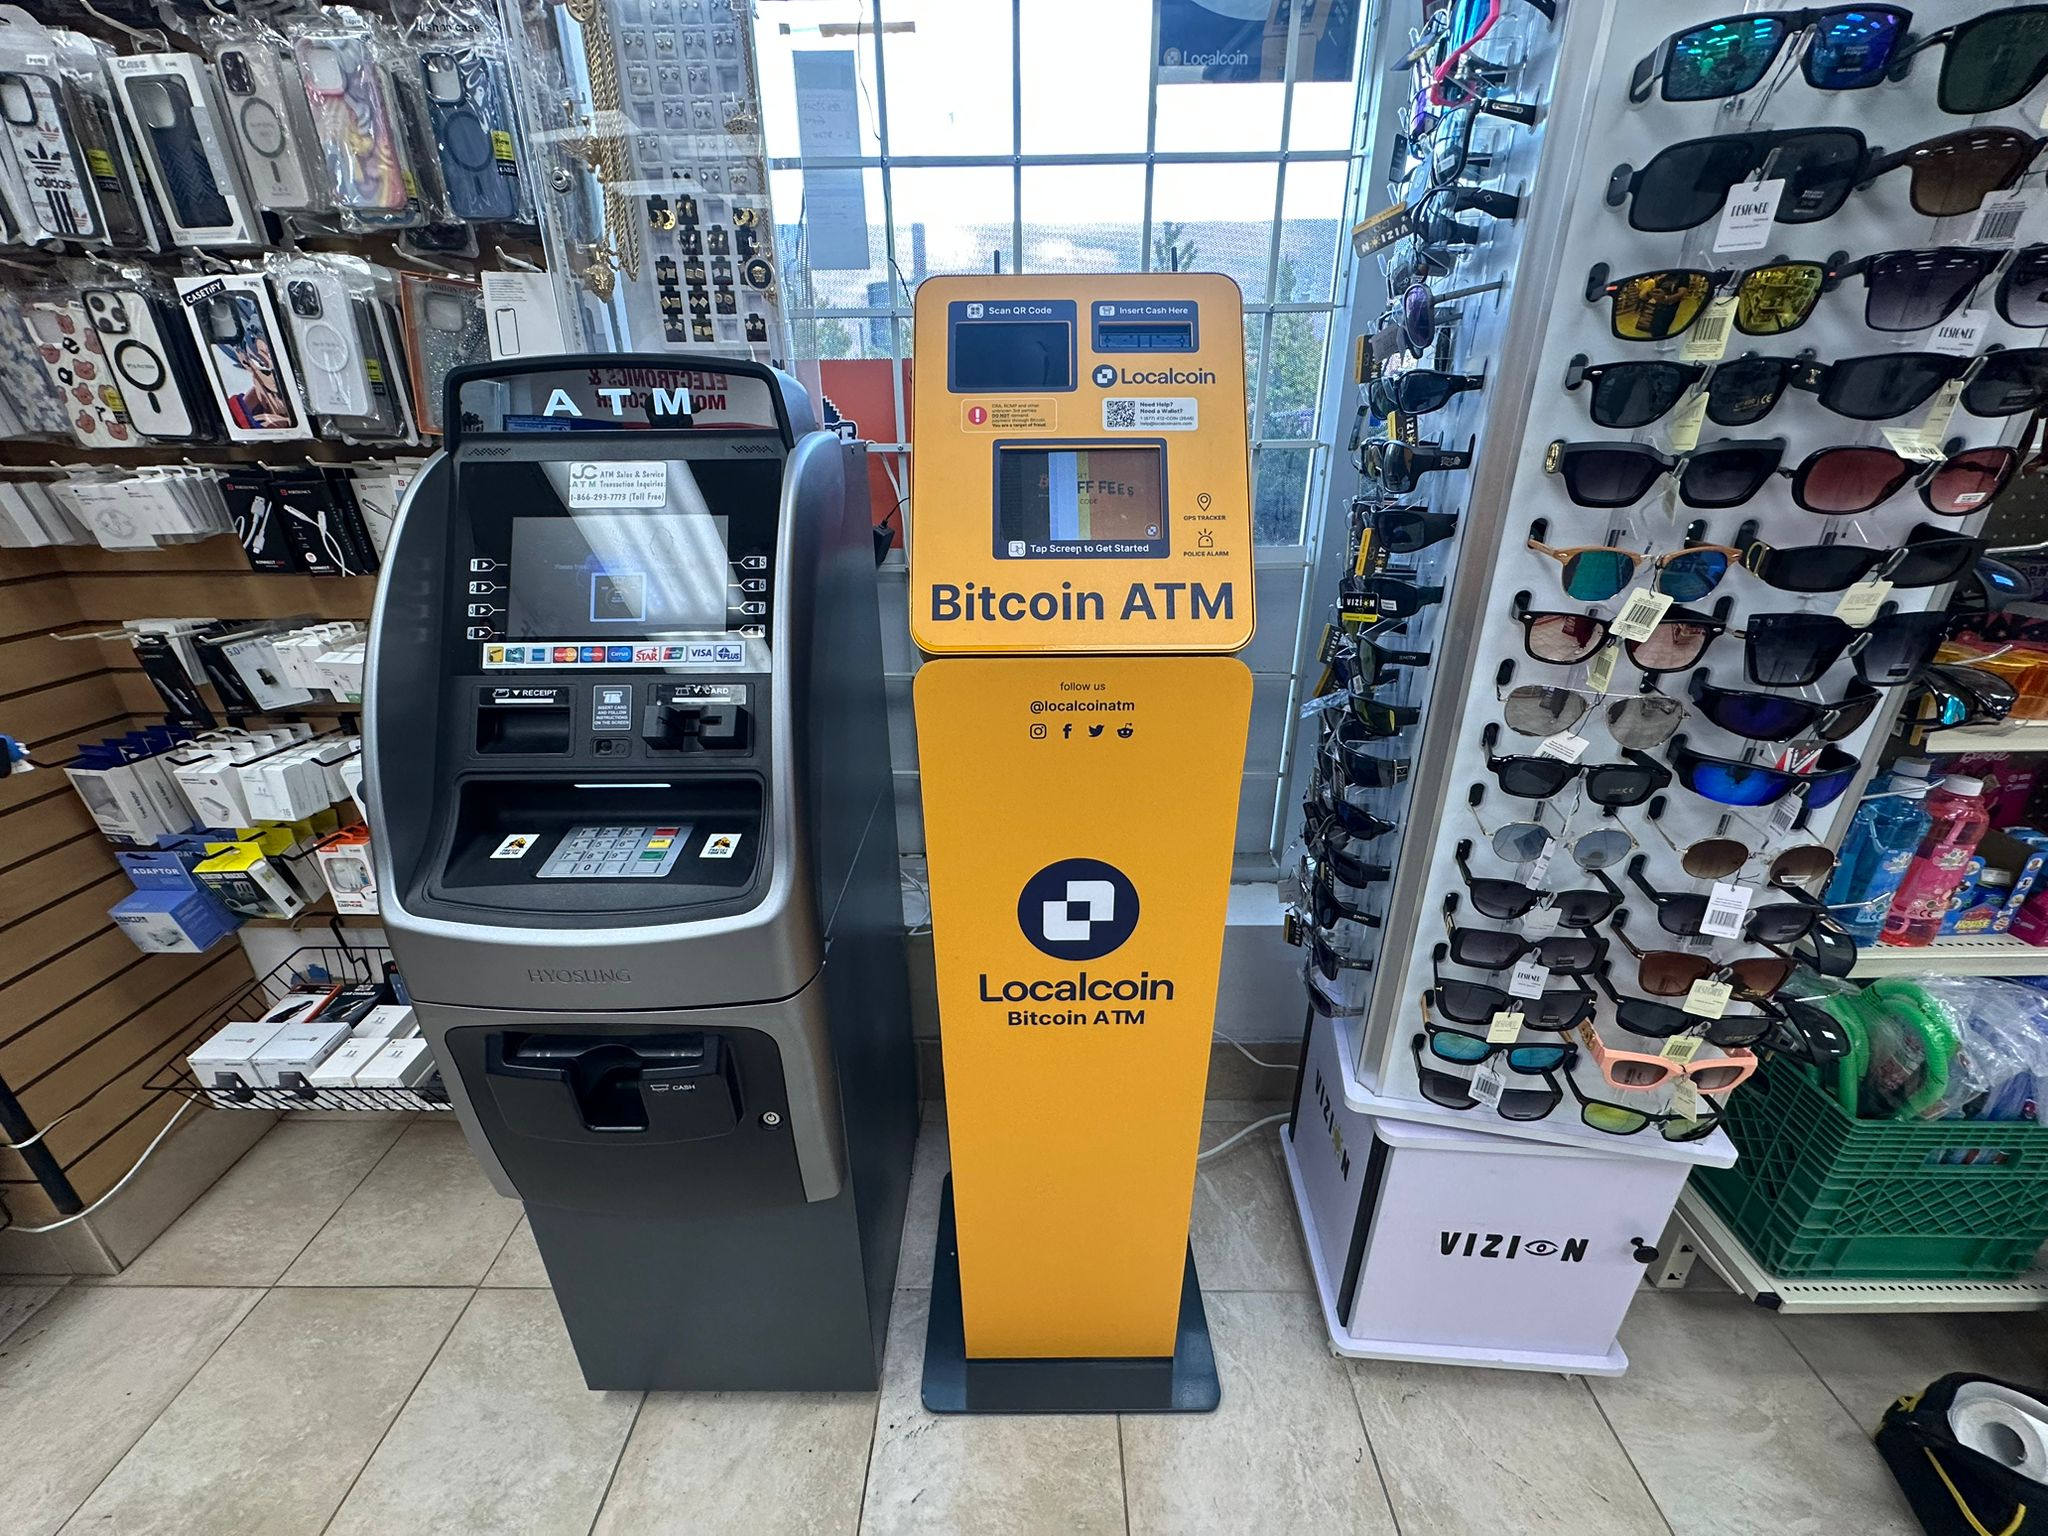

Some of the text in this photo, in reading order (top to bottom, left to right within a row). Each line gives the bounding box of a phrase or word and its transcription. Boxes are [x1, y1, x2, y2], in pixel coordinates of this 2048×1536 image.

[1183, 49, 1248, 67] Localcoin
[34, 176, 72, 189] adidas
[1731, 202, 1769, 217] DESIGNER
[185, 282, 222, 304] CASETIFY
[988, 306, 1052, 316] Scan QR Code
[1119, 306, 1188, 315] Insert Cash Here
[1938, 327, 1976, 339] DESIGNER
[1121, 367, 1216, 385] Localcoin
[543, 388, 691, 417] ATM
[629, 492, 645, 501] (Toll
[647, 493, 665, 501] Free)
[1030, 544, 1149, 554] Tap Screen to Get Started
[931, 582, 1234, 621] Bitcoin ATM
[1346, 599, 1375, 608] VIZION
[635, 652, 657, 661] STAR
[691, 649, 712, 657] VISA
[722, 652, 740, 660] PLUS
[704, 687, 729, 695] CARD
[1060, 681, 1106, 691] follow us
[522, 689, 558, 697] RECEIPT
[1030, 700, 1135, 714] @localcoinatm
[132, 867, 180, 875] ADAPTOR
[528, 968, 632, 984] HYOSUNG
[979, 971, 1174, 1002] Localcoin
[1008, 1010, 1145, 1026] Bitcoin ATM
[1440, 1231, 1590, 1263] VIZION
